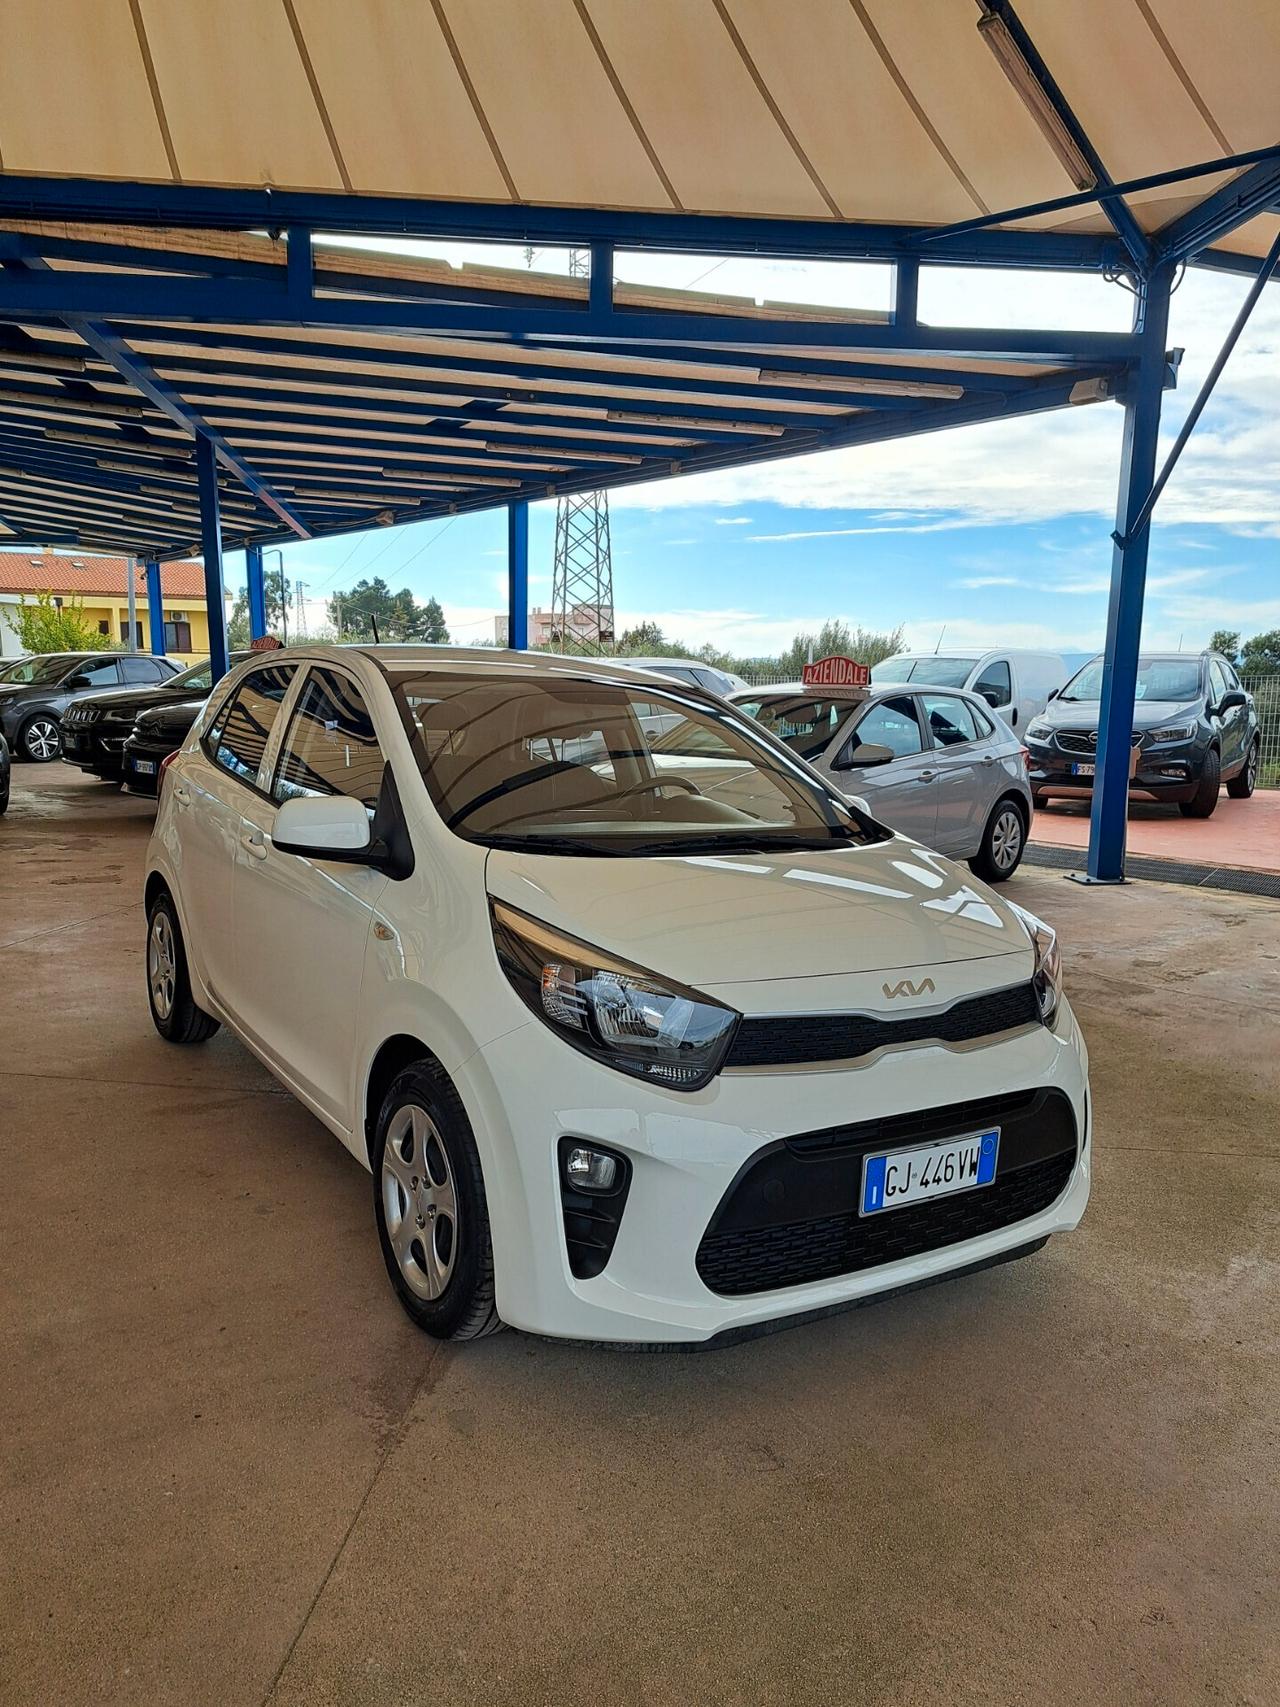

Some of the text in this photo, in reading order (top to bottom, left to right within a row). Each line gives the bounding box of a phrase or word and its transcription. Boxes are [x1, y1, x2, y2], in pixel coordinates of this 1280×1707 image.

[804, 658, 867, 684] AZIENDALE
[881, 977, 936, 999] KIA
[885, 1161, 912, 1197] GJ
[919, 1146, 980, 1188] 446VW
